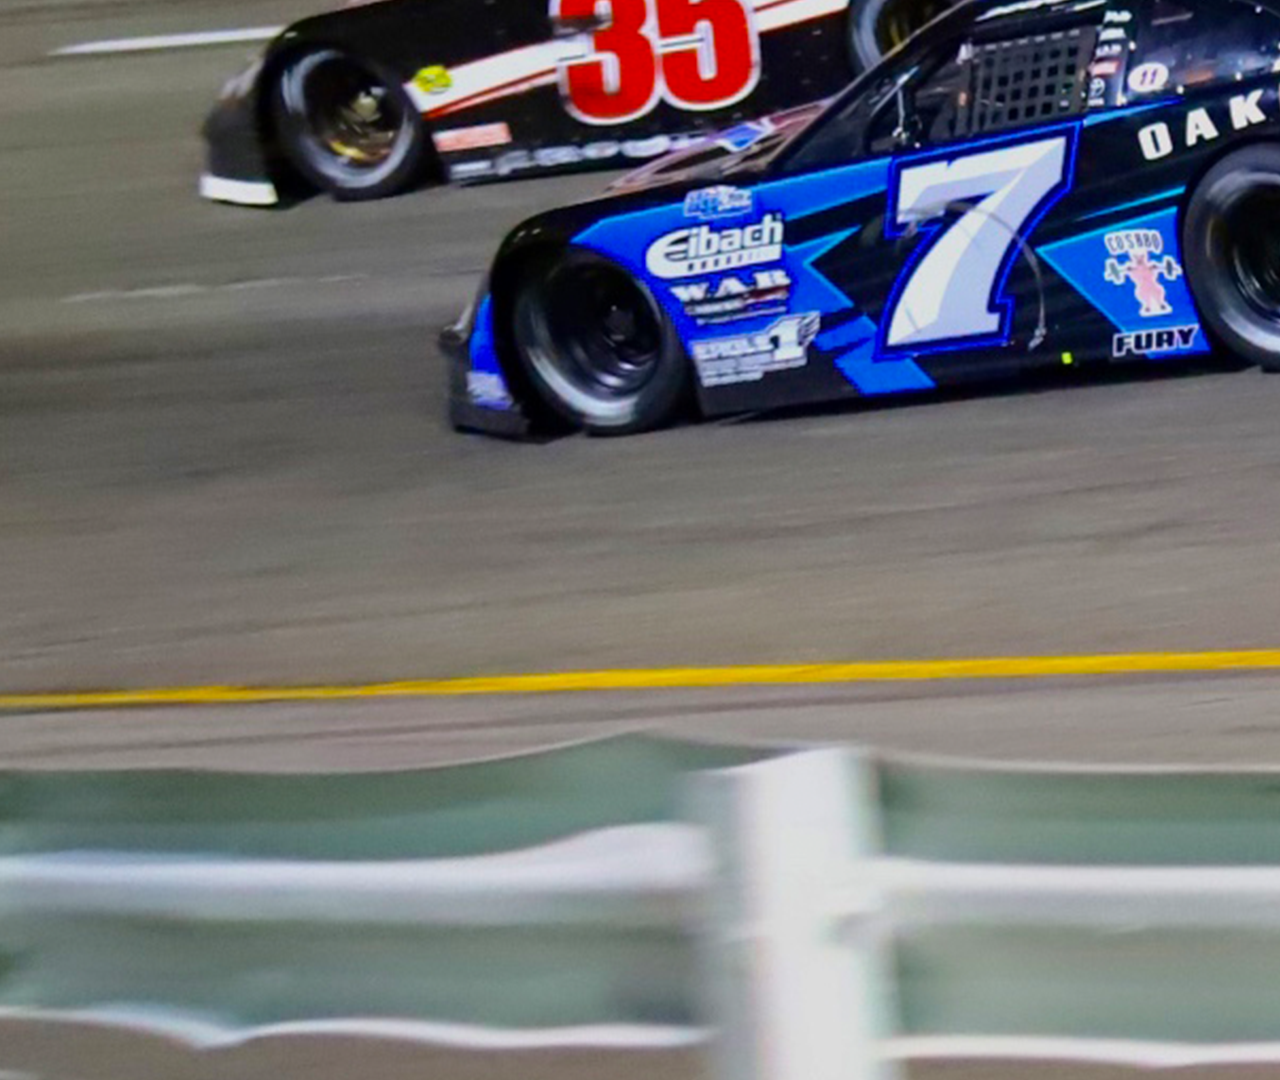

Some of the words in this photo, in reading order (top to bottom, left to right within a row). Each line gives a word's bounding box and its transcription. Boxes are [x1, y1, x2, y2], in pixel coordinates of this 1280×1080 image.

[646, 213, 785, 278] Eibach
[887, 136, 1067, 346] 7
[1112, 323, 1200, 357] FURY
